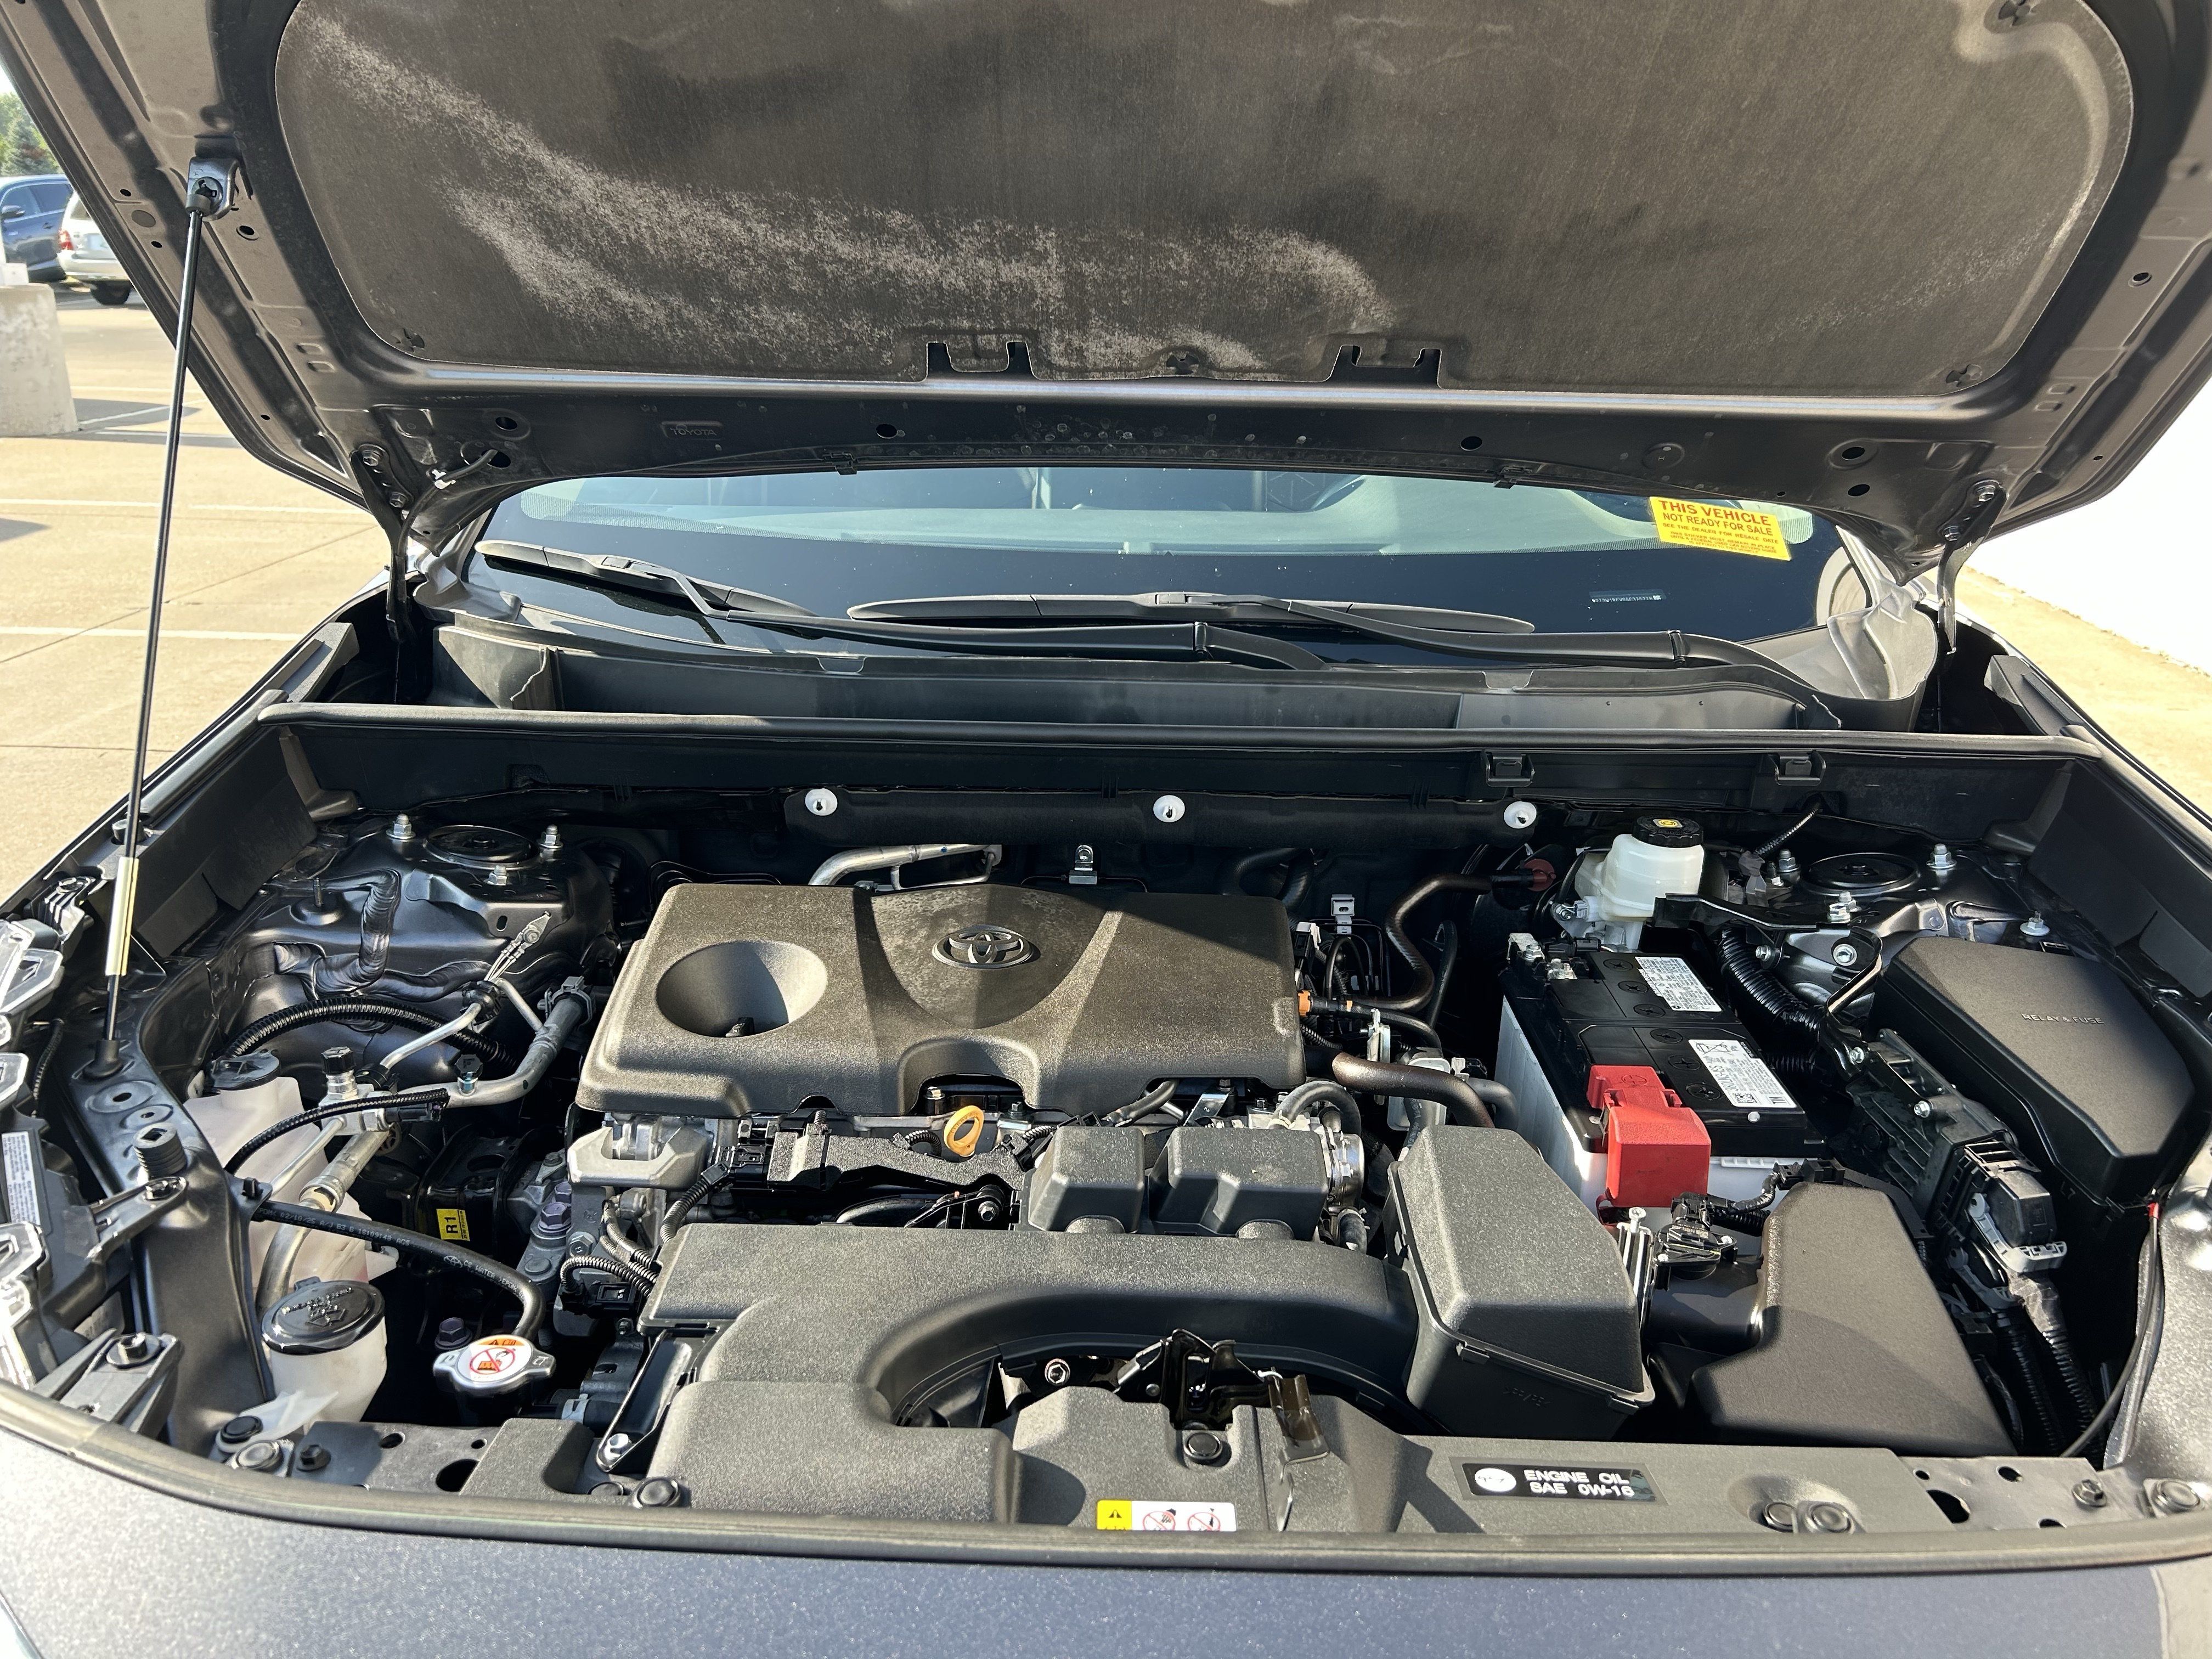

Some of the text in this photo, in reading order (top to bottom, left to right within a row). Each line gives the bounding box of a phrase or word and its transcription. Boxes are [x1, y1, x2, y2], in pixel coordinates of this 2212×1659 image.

[1658, 500, 1771, 526] THIS VEHICLE
[1662, 512, 1773, 536] NOT READY FOR SALE
[280, 1212, 317, 1224] 02/10/25
[444, 1217, 459, 1234] R1
[475, 1265, 496, 1279] WATER
[1523, 1469, 1629, 1485] ENGINE OIL
[1530, 1482, 1635, 1498] SAE 0W-16
